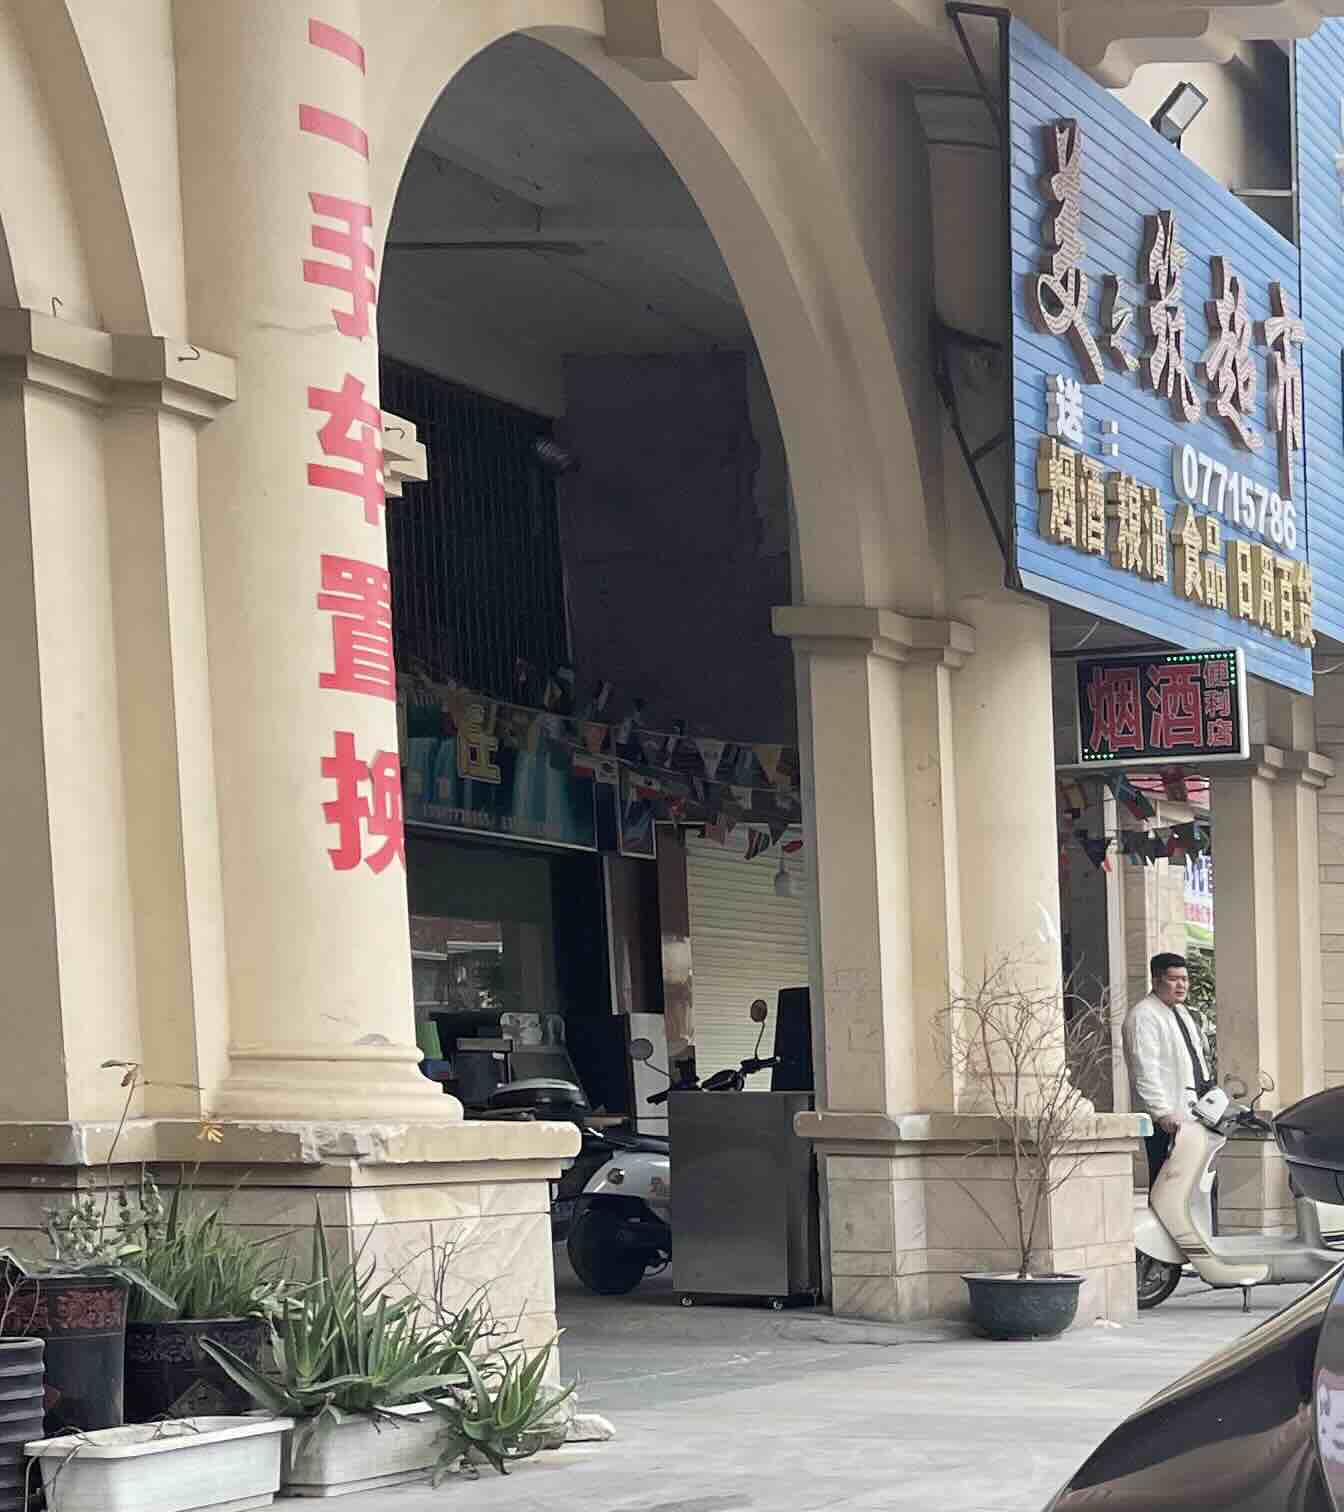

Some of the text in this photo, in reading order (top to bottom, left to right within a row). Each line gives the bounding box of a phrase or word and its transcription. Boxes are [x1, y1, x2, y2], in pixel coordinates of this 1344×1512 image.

[299, 18, 406, 873] 二手车置换
[1177, 444, 1298, 550] 07715786
[1089, 664, 1203, 752] 烟酒
[1204, 660, 1233, 747] 便利店
